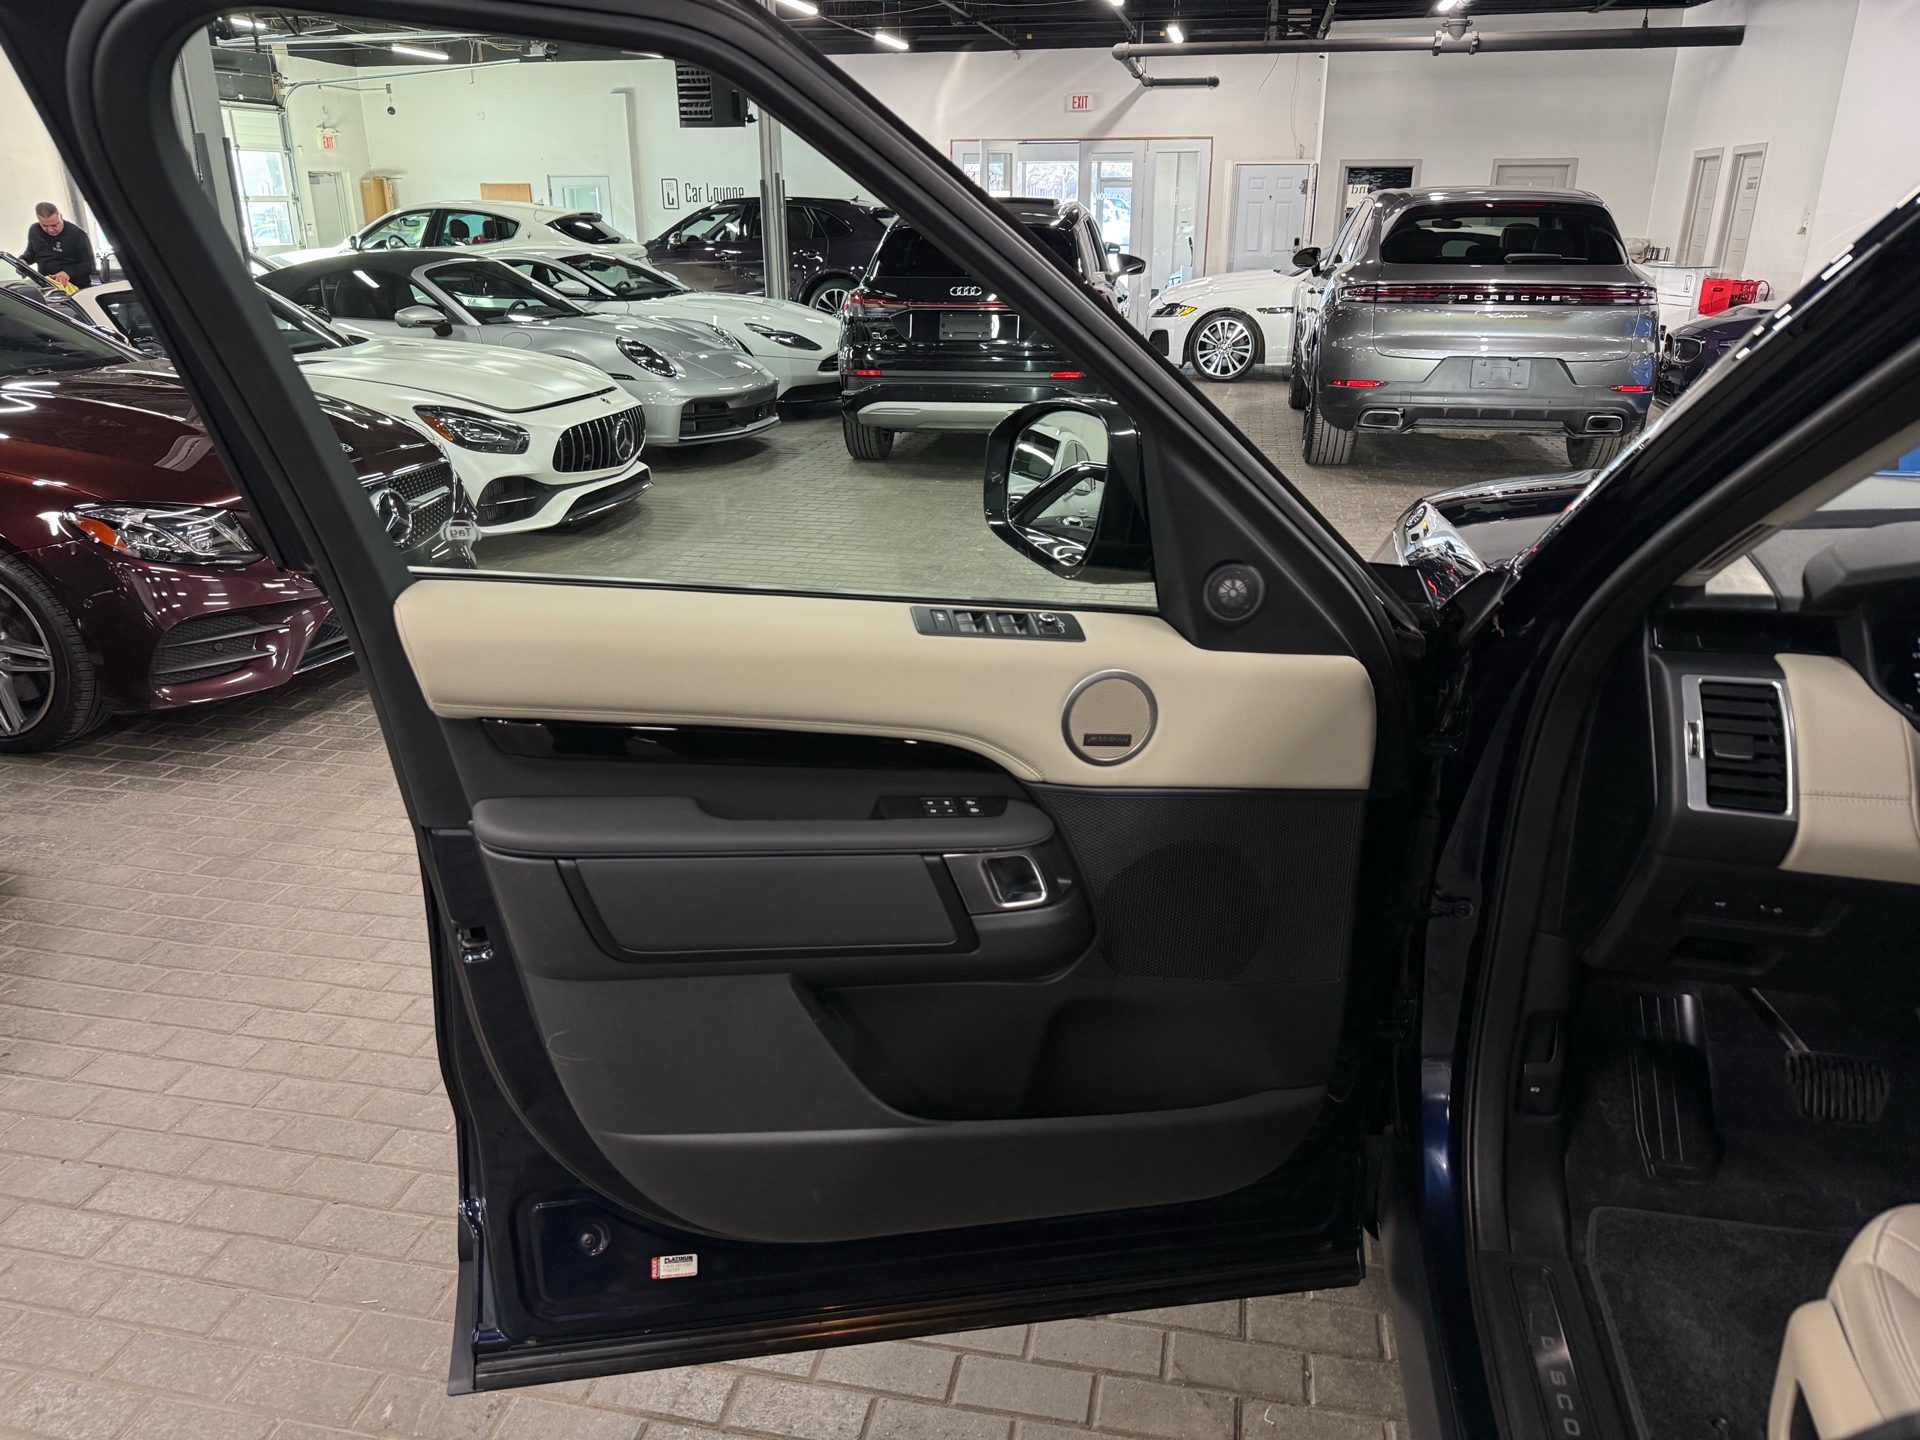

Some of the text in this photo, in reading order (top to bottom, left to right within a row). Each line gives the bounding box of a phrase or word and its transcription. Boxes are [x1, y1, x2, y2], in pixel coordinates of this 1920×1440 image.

[1072, 95, 1088, 109] EXIT
[685, 183, 702, 202] Car
[1458, 294, 1561, 302] PORSCHE
[664, 1256, 693, 1264] PLATINUM
